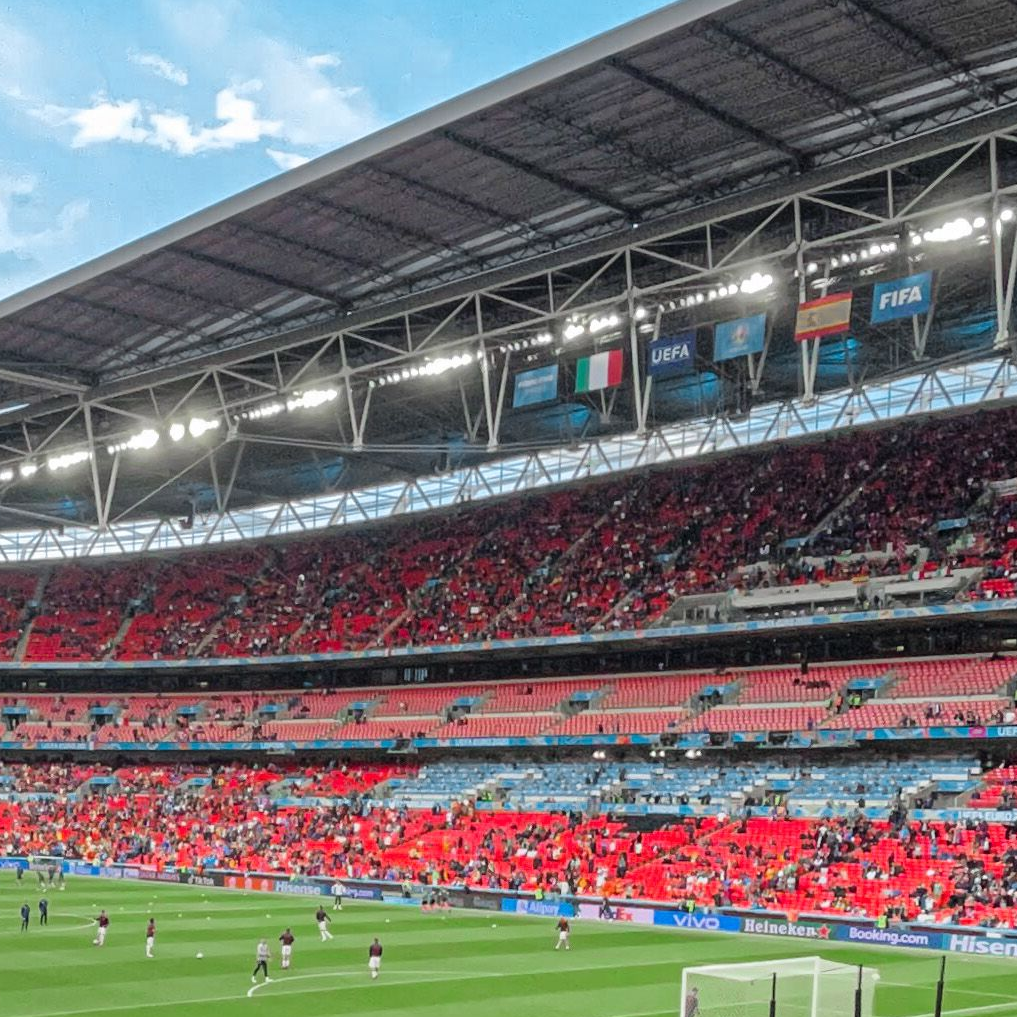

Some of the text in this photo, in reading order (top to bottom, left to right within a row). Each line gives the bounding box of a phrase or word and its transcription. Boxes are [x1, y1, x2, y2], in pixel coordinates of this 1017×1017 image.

[879, 285, 922, 310] FIFA
[651, 344, 689, 364] UEFA
[275, 881, 320, 895] Hisense
[673, 912, 720, 930] vivo
[744, 918, 817, 936] Heineken
[849, 926, 928, 945] Booking.com
